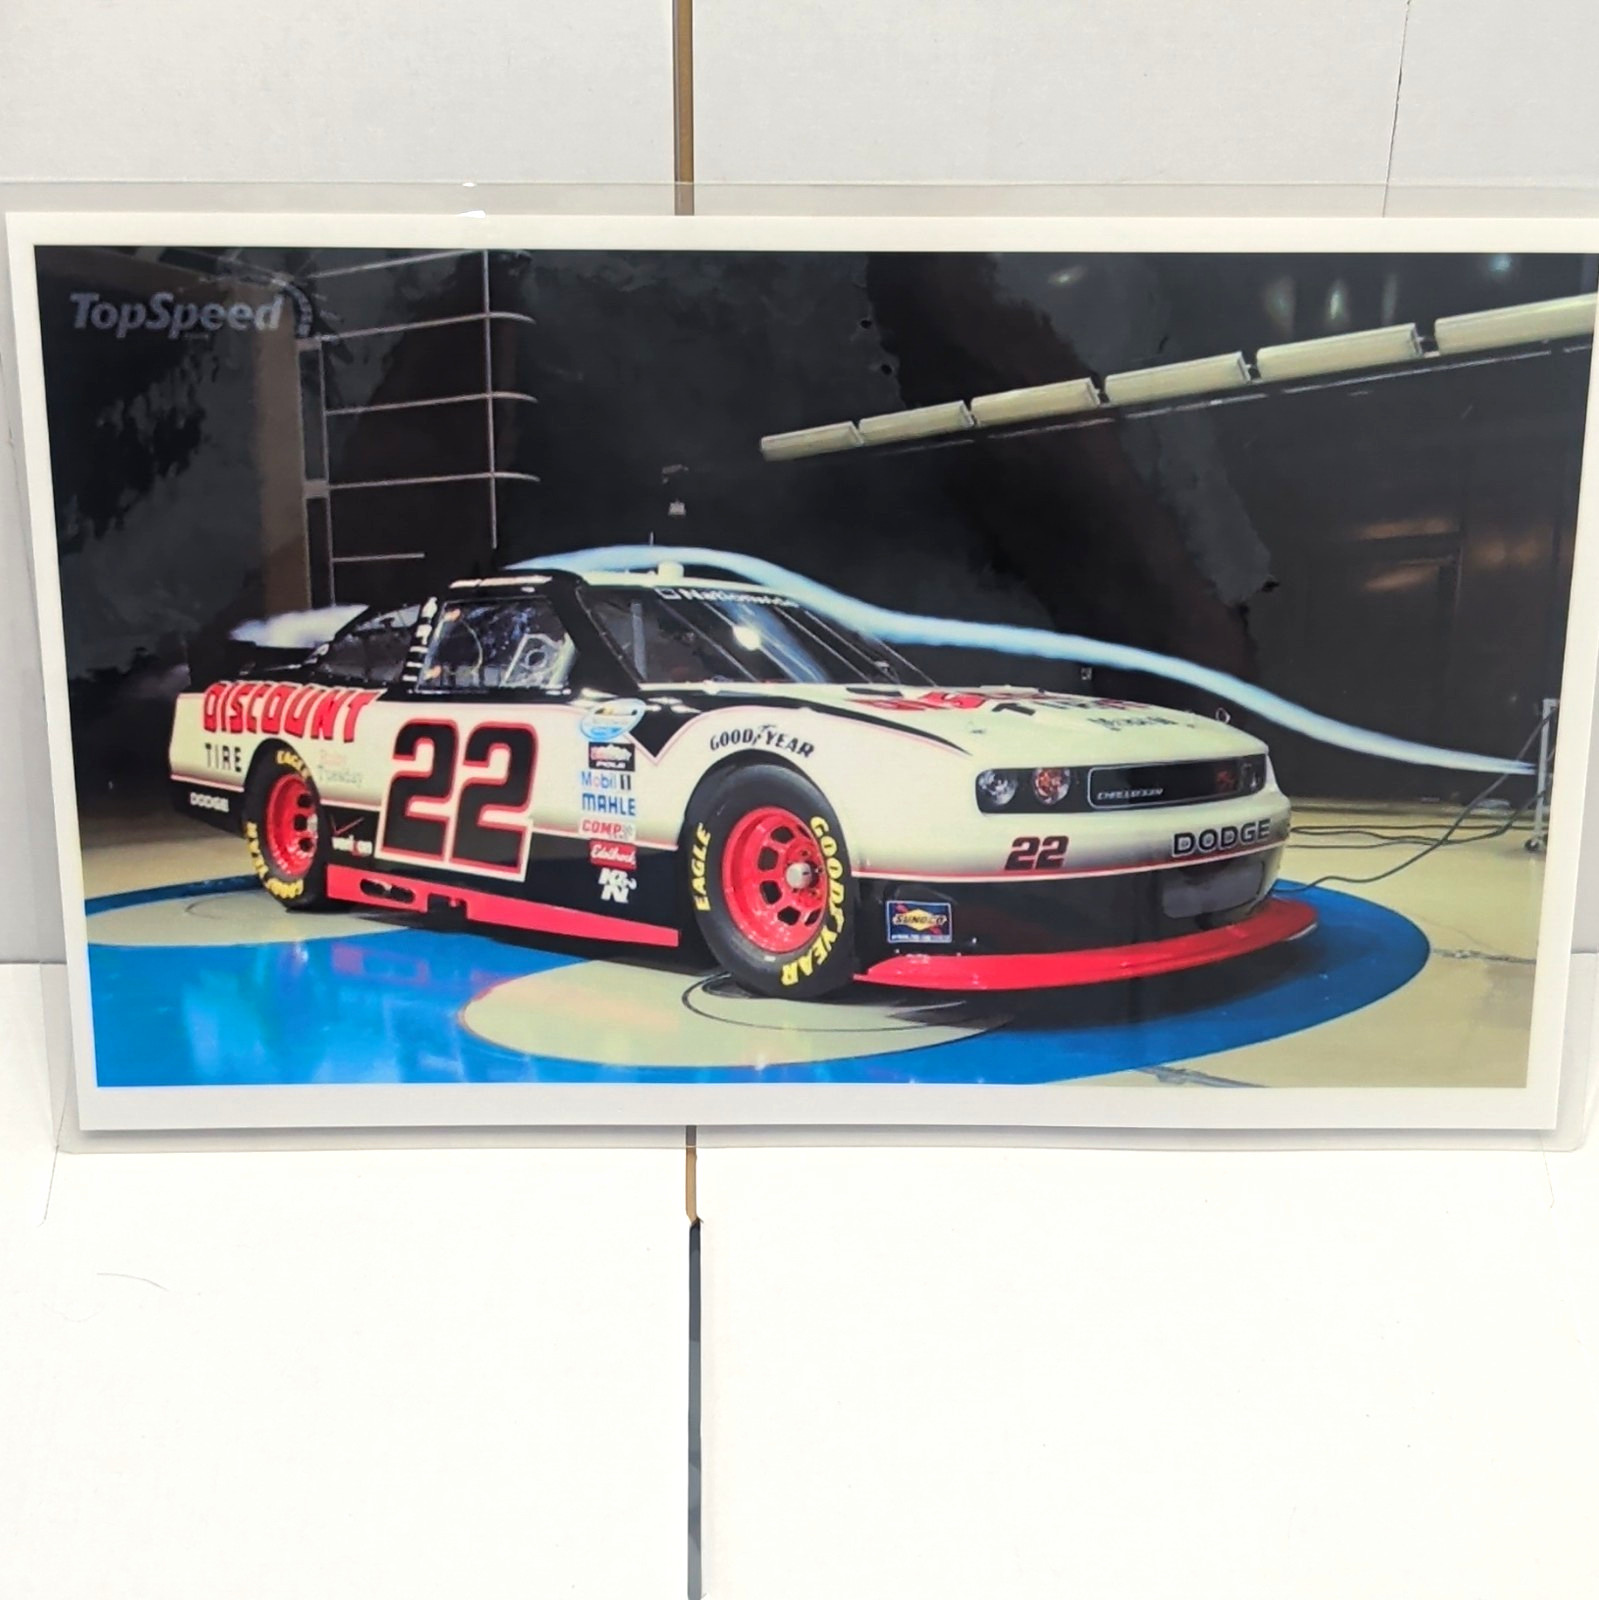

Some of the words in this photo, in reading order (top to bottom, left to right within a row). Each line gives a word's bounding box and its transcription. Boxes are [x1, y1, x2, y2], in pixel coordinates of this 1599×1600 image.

[70, 291, 283, 339] TopSpeed
[203, 681, 386, 743] DISCOUNT
[205, 743, 242, 773] TIRE
[376, 718, 538, 882] 22
[581, 771, 617, 790] Mobil
[582, 793, 636, 817] MAHLE
[1004, 835, 1070, 871] 22
[1172, 818, 1272, 857] DODGE
[690, 823, 711, 912] EAGLE
